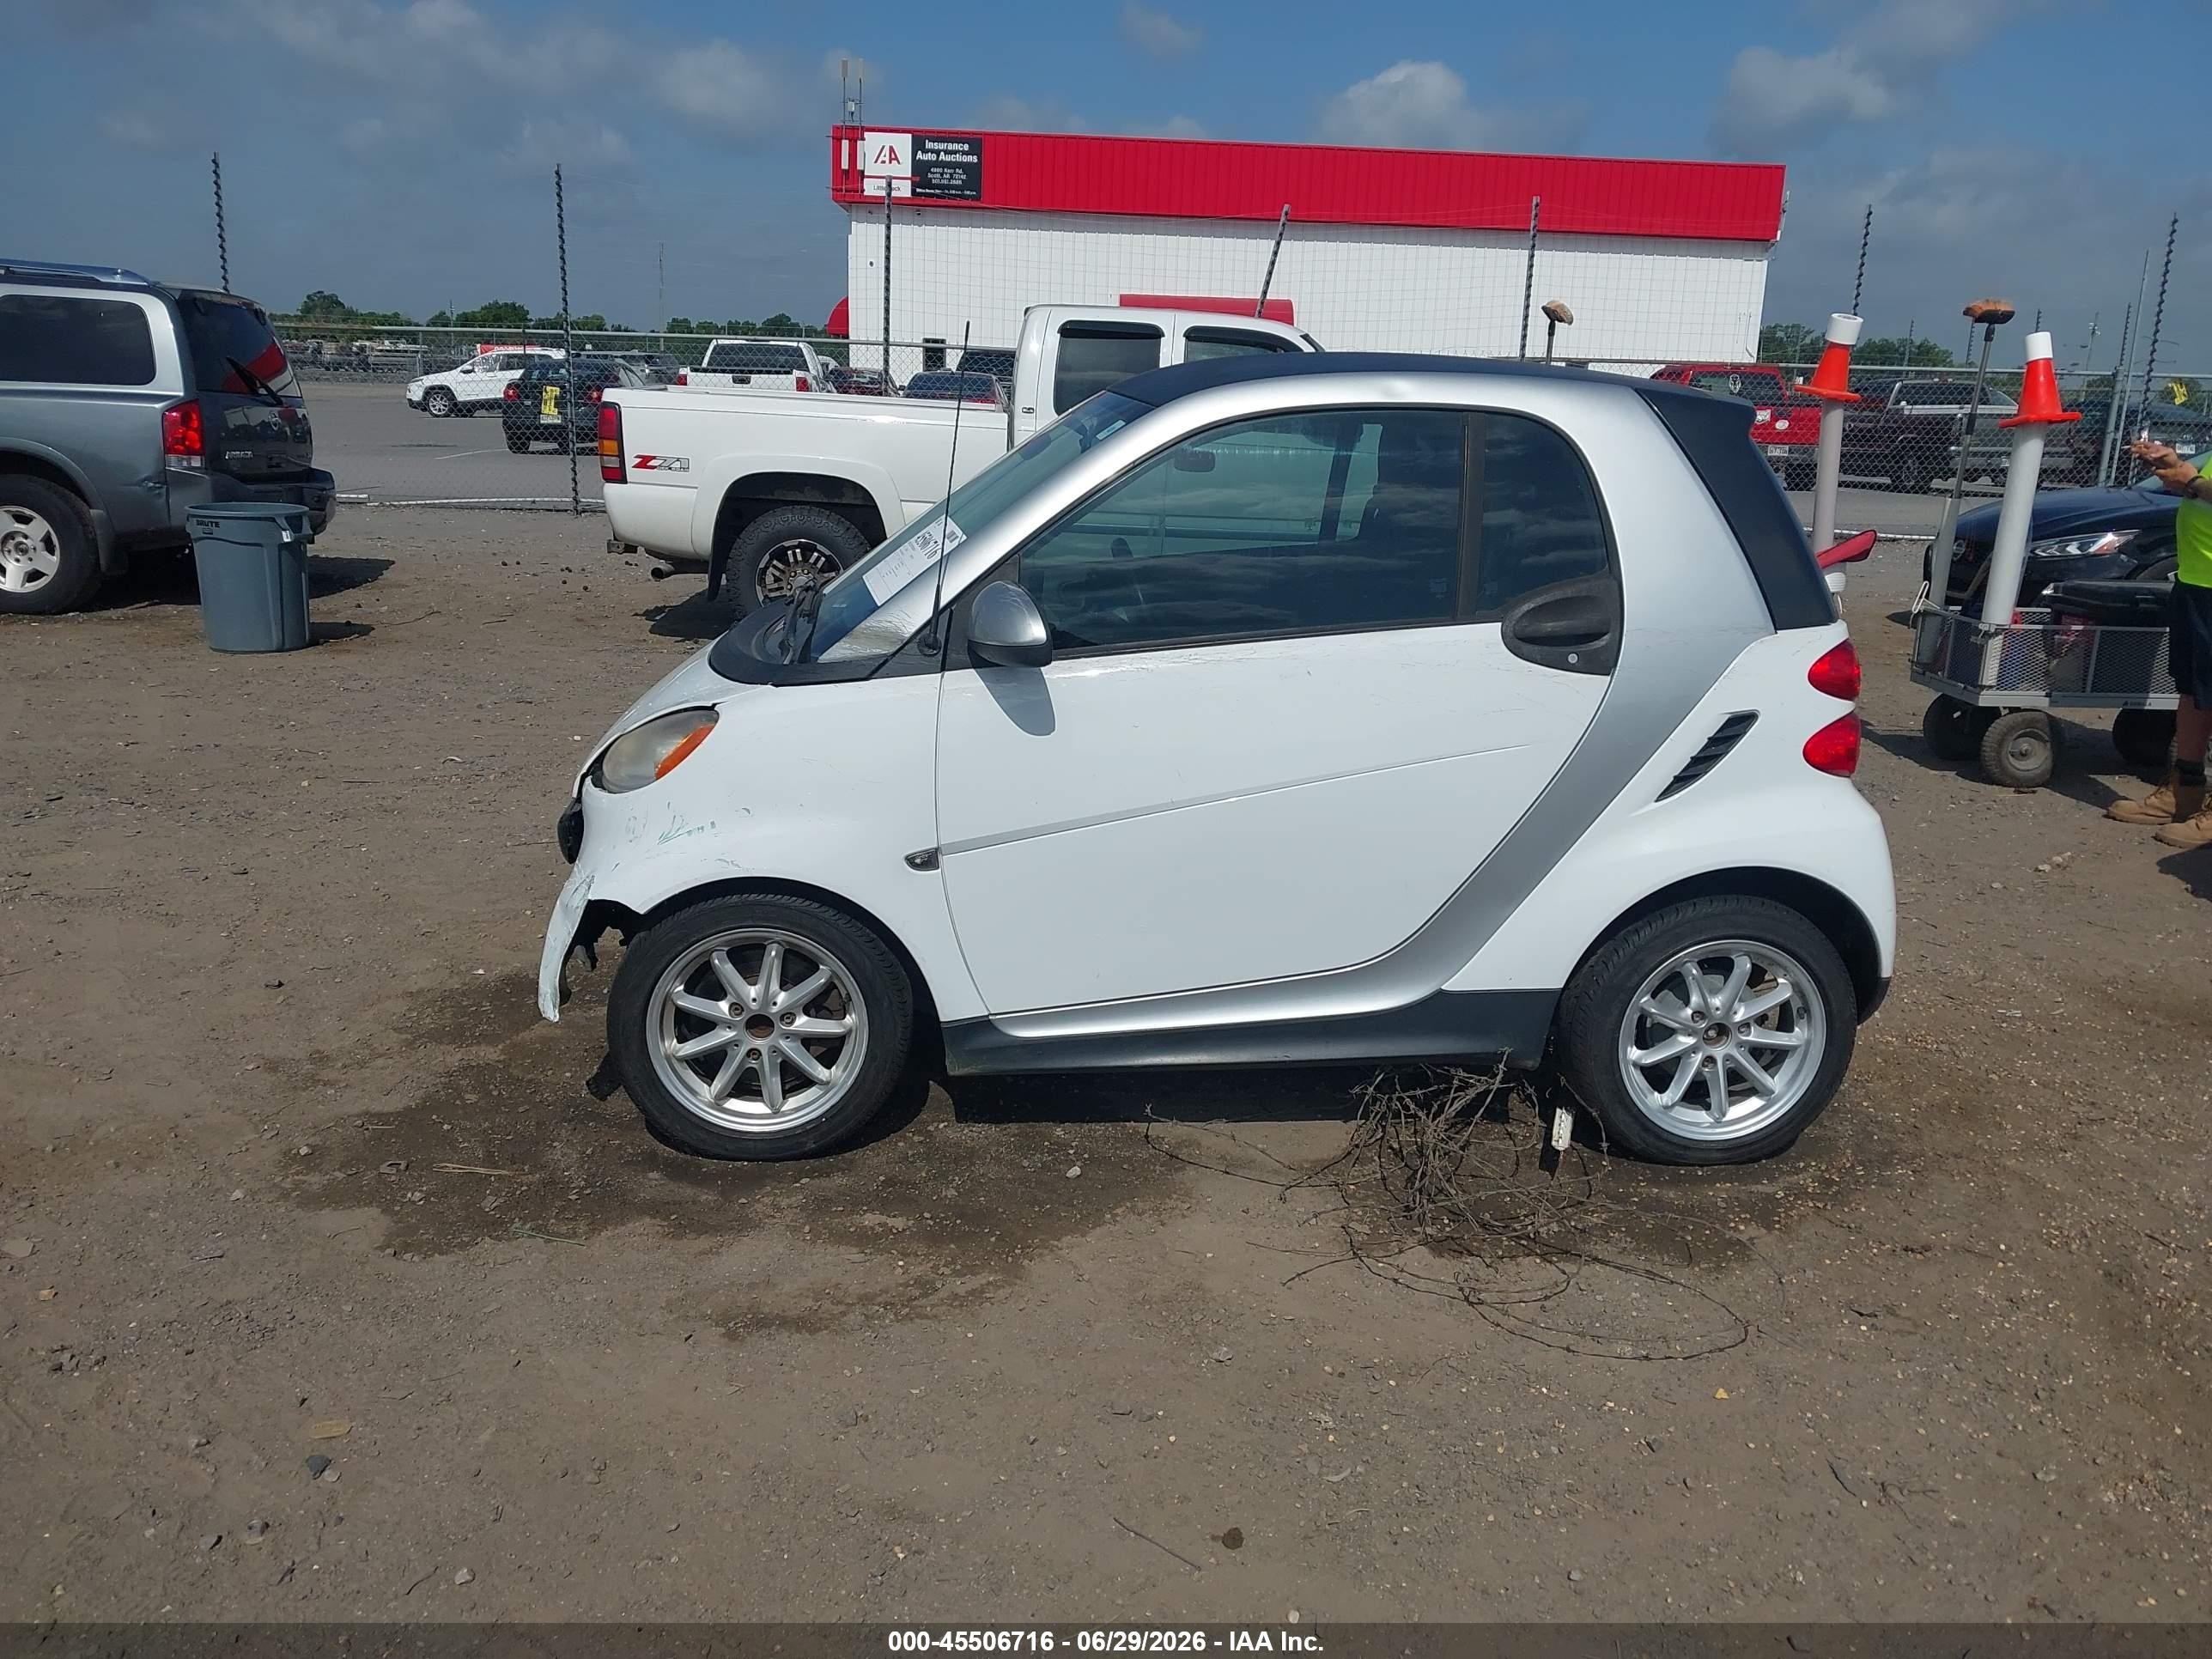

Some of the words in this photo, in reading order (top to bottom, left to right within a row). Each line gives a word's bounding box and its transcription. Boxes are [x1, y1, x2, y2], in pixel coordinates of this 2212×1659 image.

[926, 139, 969, 150] Insurance
[915, 150, 937, 161] Auto
[939, 151, 978, 162] Auctions
[632, 454, 690, 471] Z71
[196, 520, 221, 528] BRUTE
